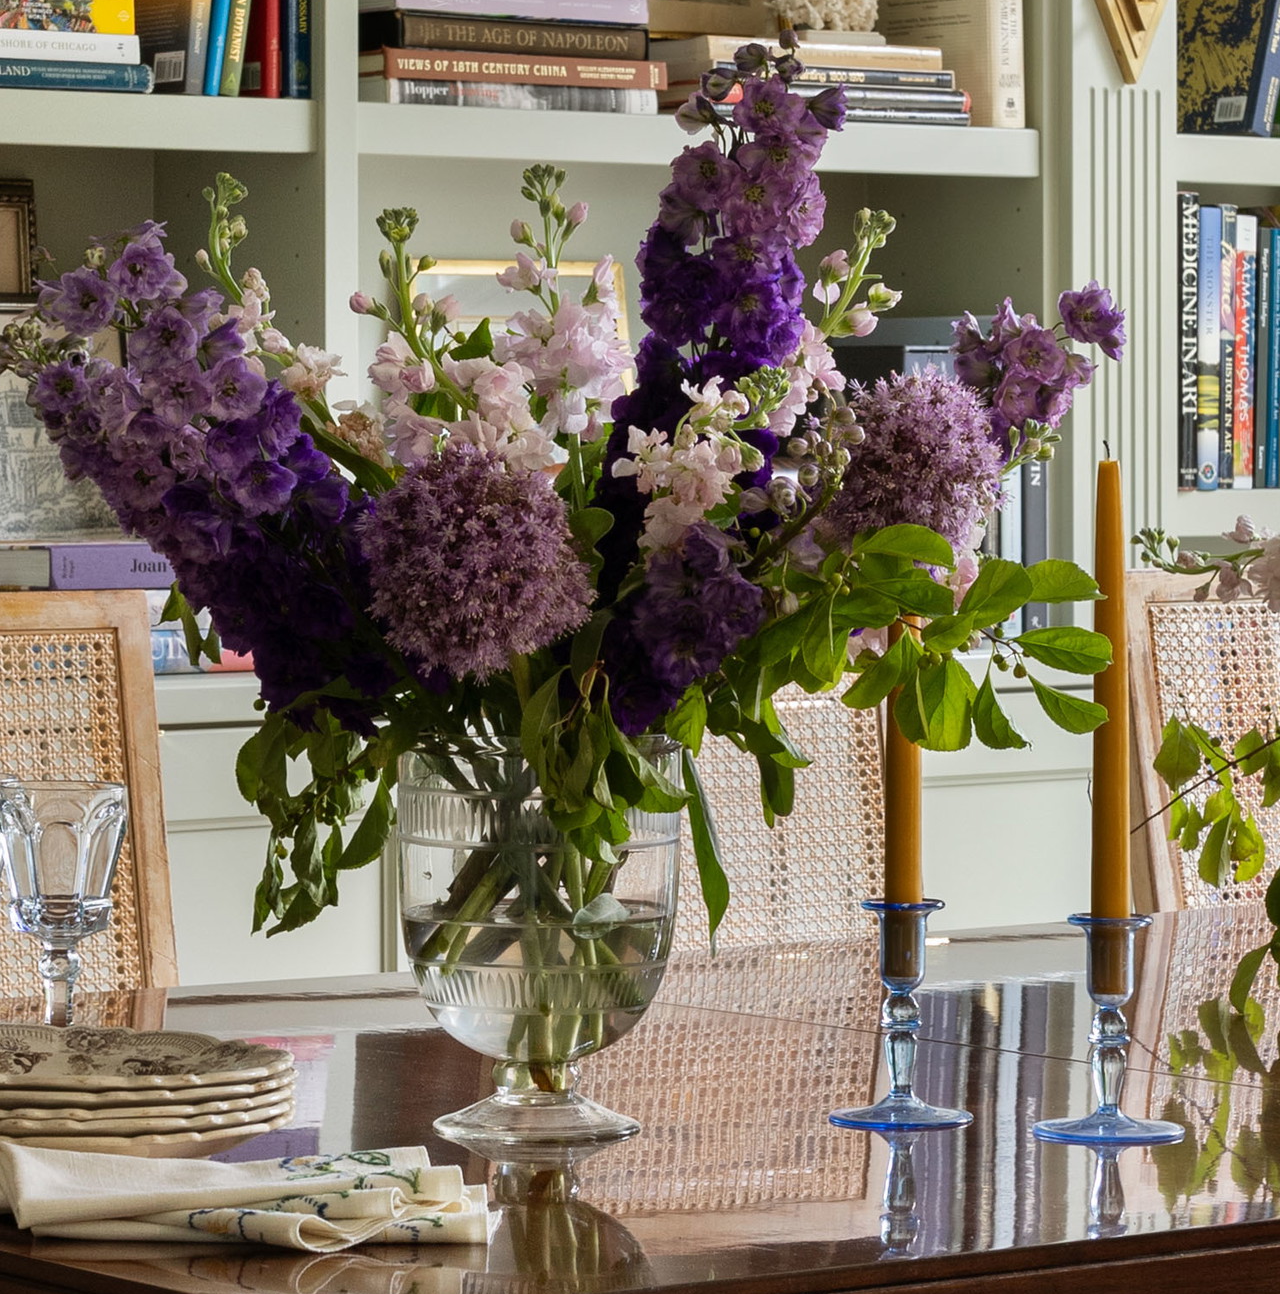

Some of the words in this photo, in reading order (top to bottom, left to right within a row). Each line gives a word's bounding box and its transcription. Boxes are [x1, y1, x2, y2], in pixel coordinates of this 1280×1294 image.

[0, 38, 33, 49] SHORE
[34, 40, 49, 50] OF
[50, 40, 97, 52] CHICAGO
[229, 8, 247, 63] BOTANIST
[443, 23, 478, 43] THE
[481, 28, 512, 45] AGE
[516, 29, 538, 46] OF
[541, 31, 629, 54] NAPOLEON
[397, 58, 432, 71] VIEWS
[434, 60, 449, 72] OF
[451, 61, 479, 73] 18TH
[482, 62, 531, 76] CENTURY
[533, 64, 568, 78] CHINA
[1182, 201, 1200, 332] MEDICINE
[1241, 259, 1251, 311] ALMA
[1182, 336, 1197, 363] IN
[1224, 342, 1233, 354] A
[1182, 364, 1198, 421] ART
[1224, 356, 1233, 416] HISTORY
[1237, 344, 1251, 422] THOMAS
[1224, 418, 1233, 432] IN
[1224, 433, 1233, 456] ART
[129, 557, 169, 574] Joan
